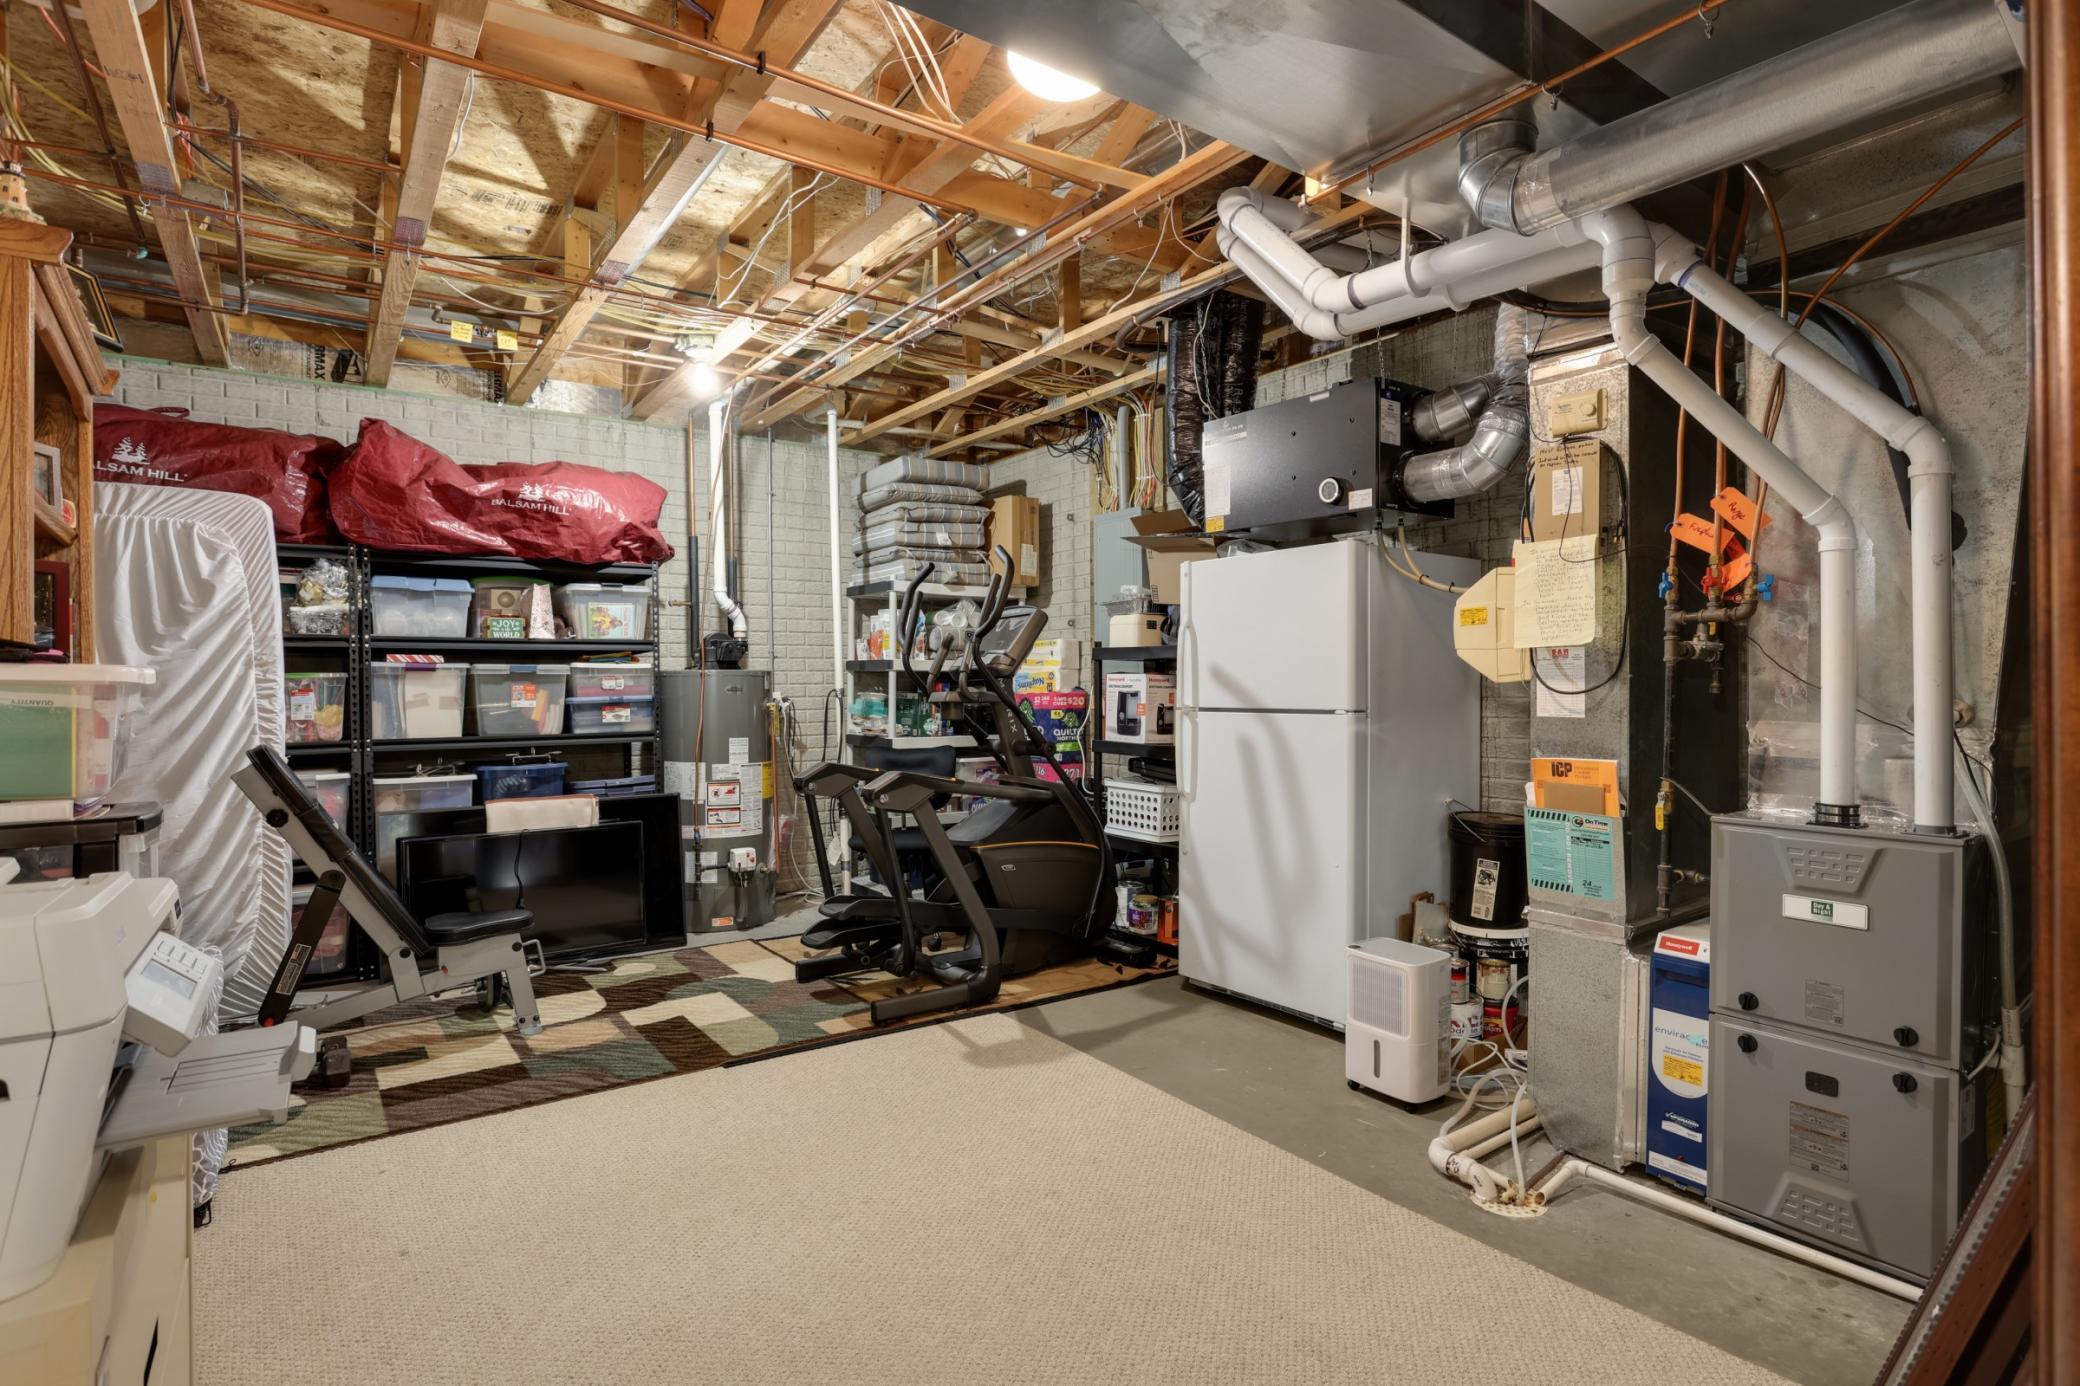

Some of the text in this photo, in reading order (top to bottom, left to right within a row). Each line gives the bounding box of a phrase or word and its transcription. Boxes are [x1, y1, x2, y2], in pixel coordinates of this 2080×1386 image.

[93, 461, 184, 482] LSAM HILL
[491, 498, 570, 515] BALSAM HILL
[496, 619, 516, 628] JOY
[493, 631, 521, 639] WORLD
[11, 698, 54, 707] QUANTITY
[1053, 728, 1084, 736] QUILT
[1551, 761, 1573, 777] ICP
